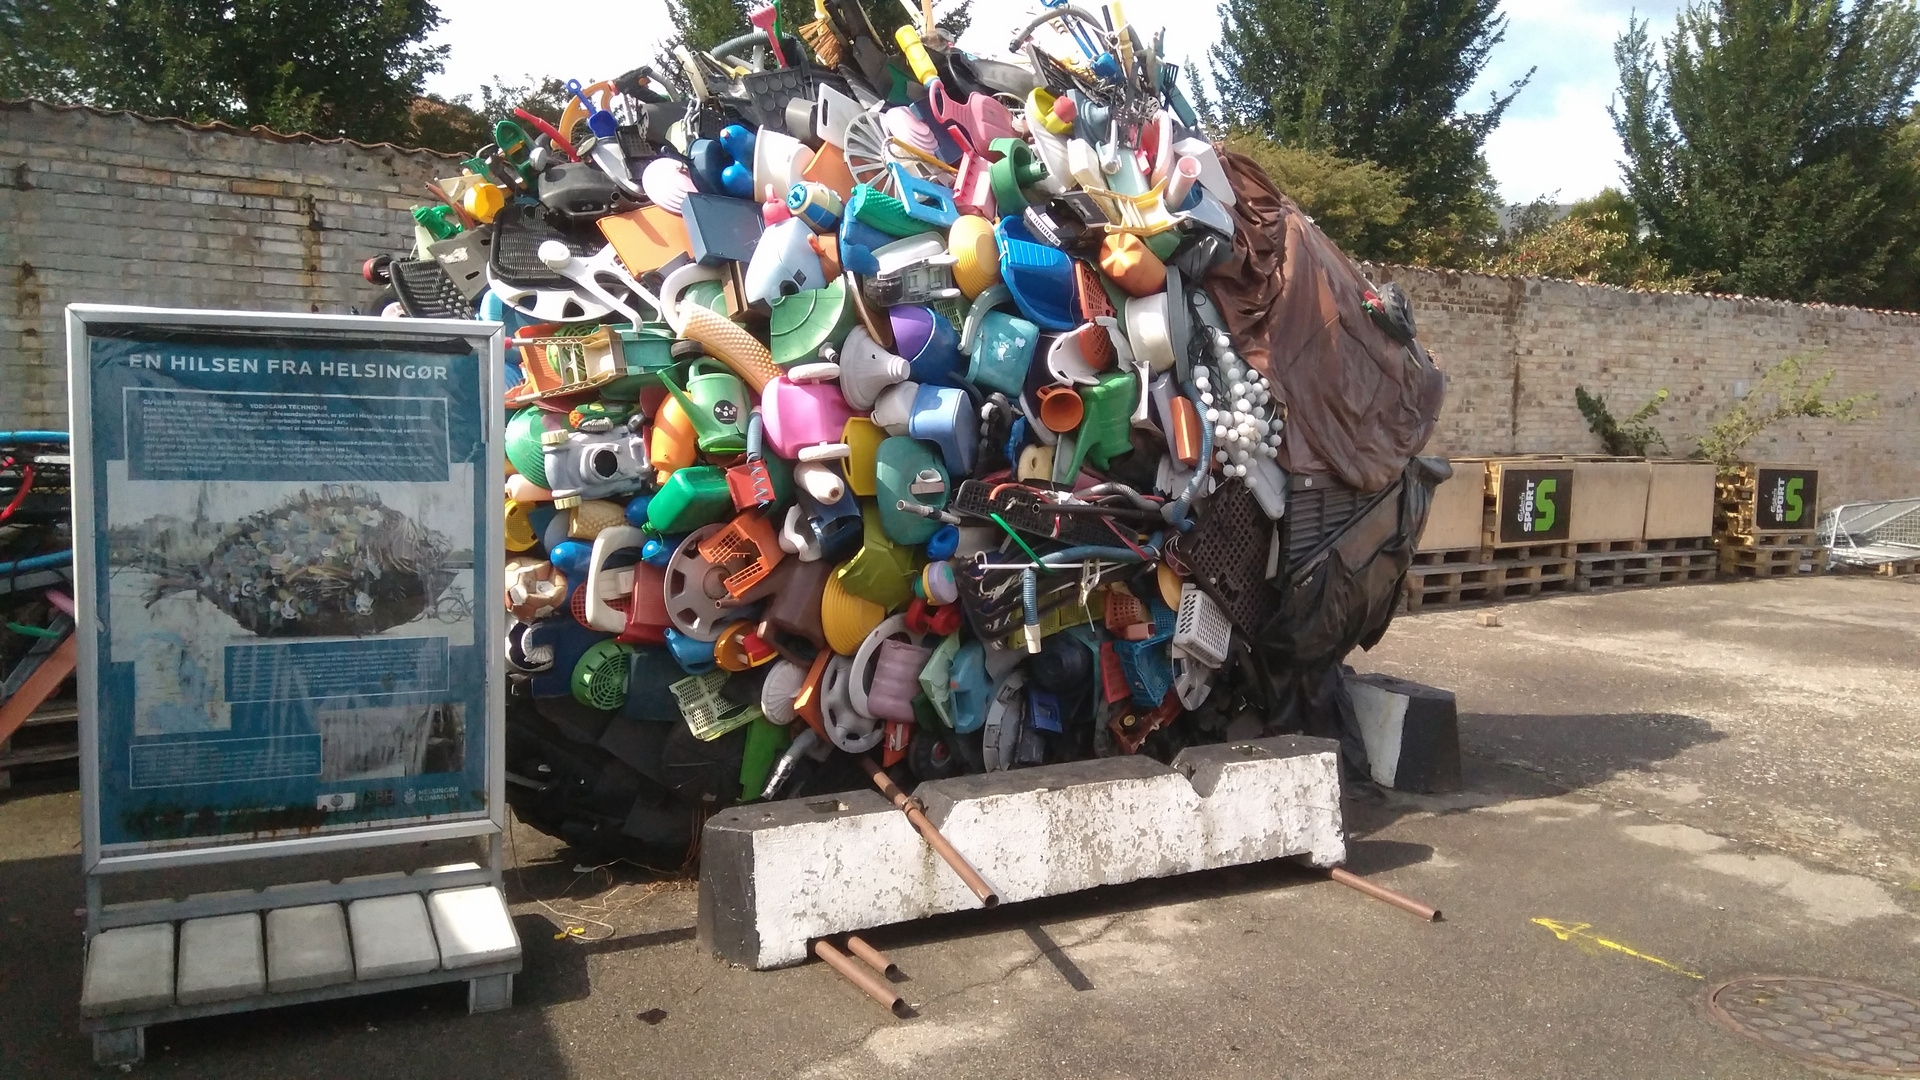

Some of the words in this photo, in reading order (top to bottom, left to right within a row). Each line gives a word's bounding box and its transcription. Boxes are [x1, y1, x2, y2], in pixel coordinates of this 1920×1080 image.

[129, 354, 161, 369] EN
[171, 355, 259, 373] HILSEN
[267, 359, 312, 375] FRA
[320, 361, 448, 380] HELSINGØR
[1523, 479, 1535, 532] SPORT
[1775, 477, 1785, 522] SPORT
